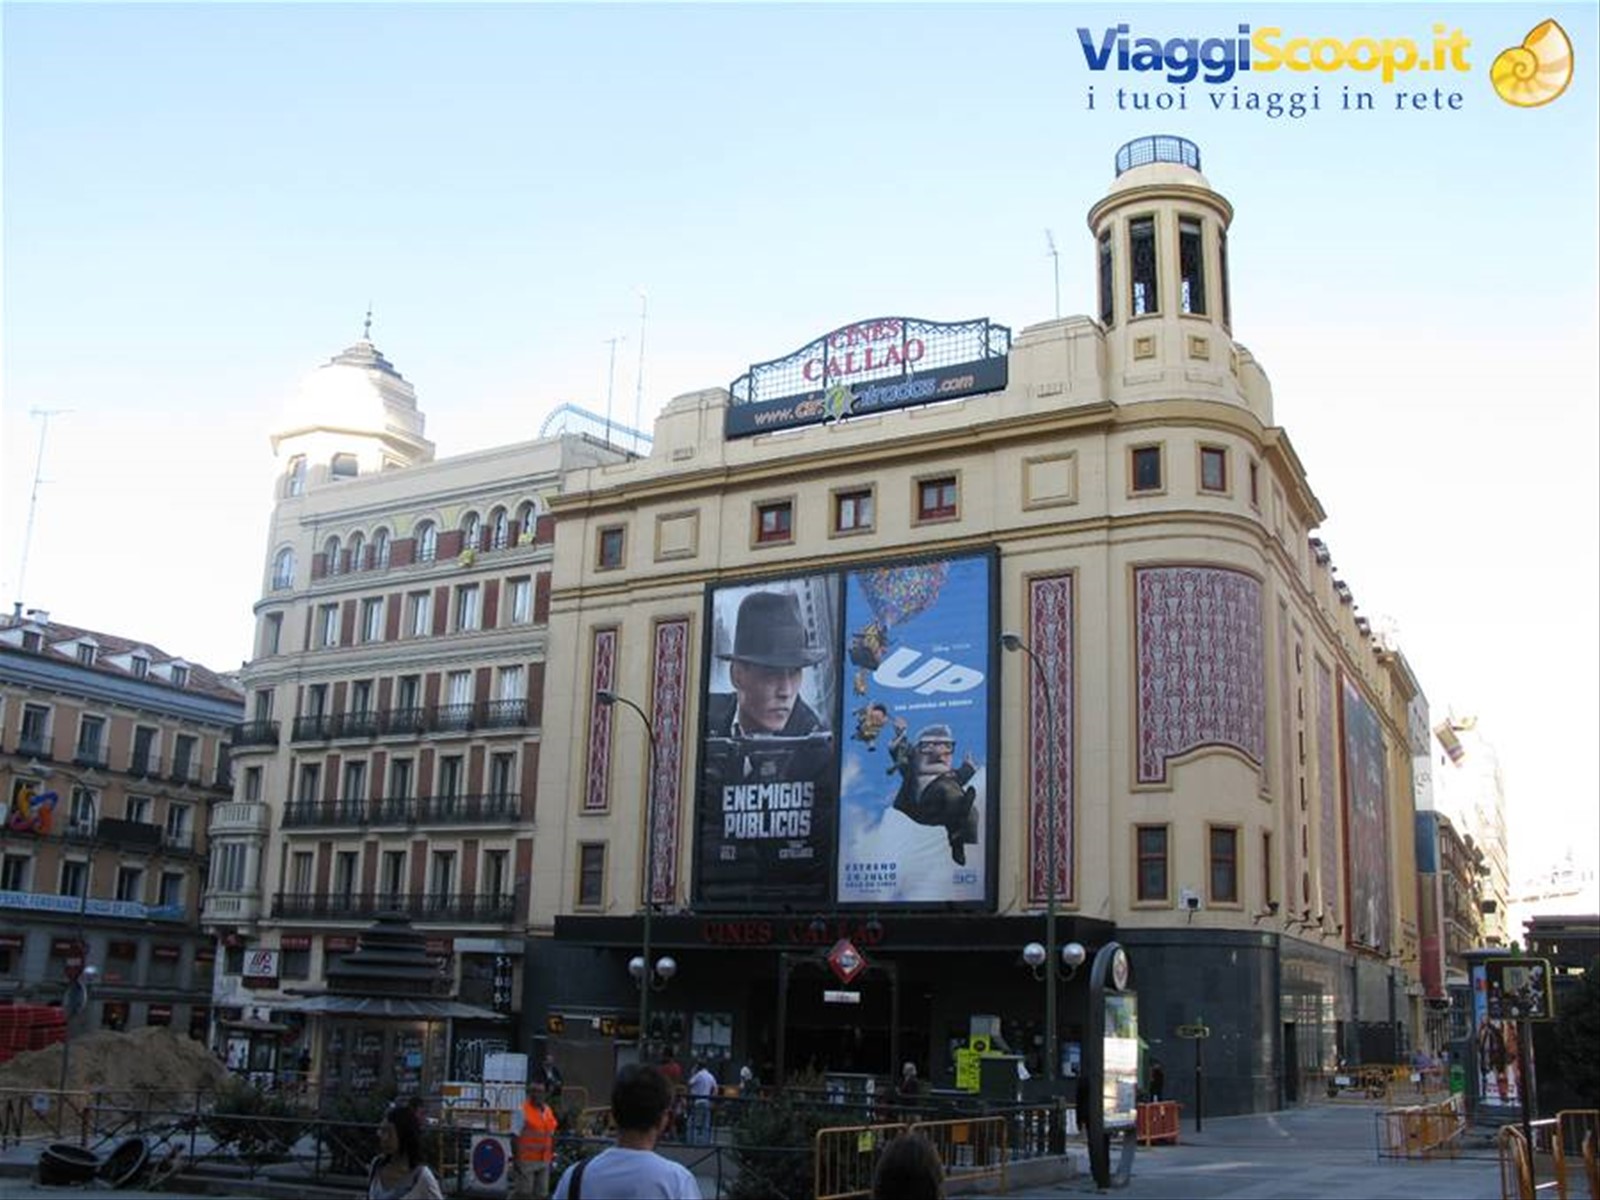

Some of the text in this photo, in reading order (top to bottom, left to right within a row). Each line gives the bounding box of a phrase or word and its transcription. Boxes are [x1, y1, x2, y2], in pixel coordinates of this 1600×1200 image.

[829, 319, 901, 349] CINES
[803, 338, 925, 382] CALLAO
[723, 782, 814, 812] ENEMIGOS
[704, 921, 773, 944] CINES
